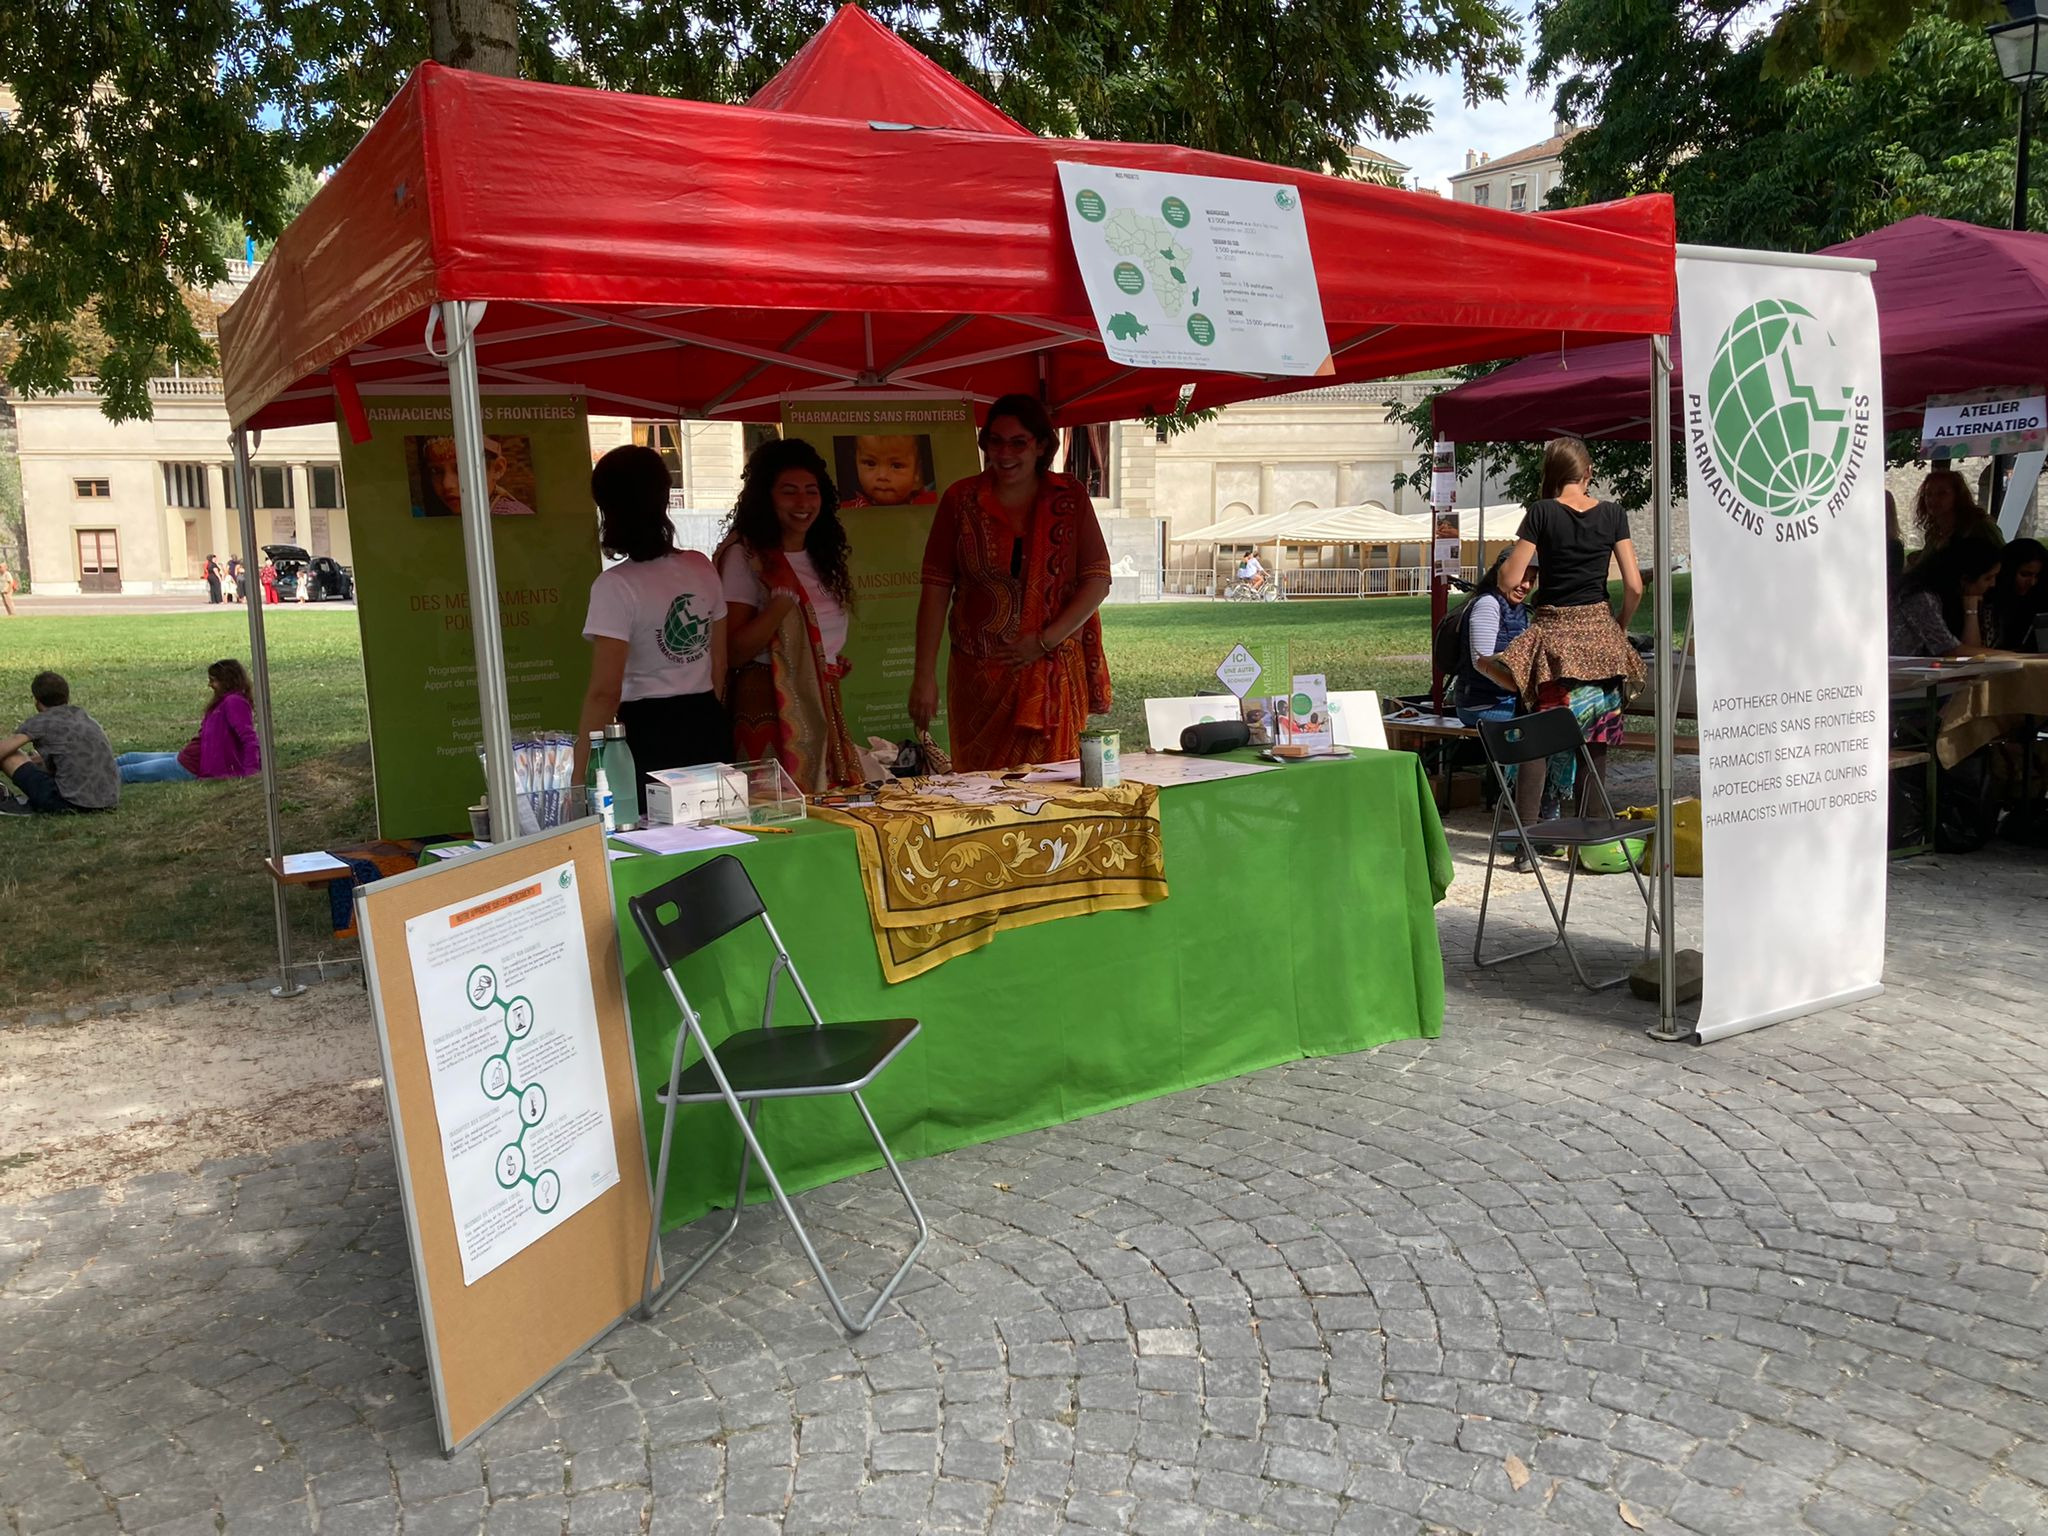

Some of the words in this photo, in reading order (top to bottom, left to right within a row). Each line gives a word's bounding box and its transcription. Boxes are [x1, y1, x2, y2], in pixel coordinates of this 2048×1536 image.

[364, 408, 452, 422] ARMACIENS
[791, 411, 871, 423] PHARMACIENS
[873, 410, 902, 422] SANS
[1959, 401, 2020, 418] ATELIER
[1935, 416, 2039, 437] ALTERNATIBO
[1688, 394, 1765, 537] PHARMACIENS
[1775, 514, 1819, 543] SANS
[858, 571, 919, 589] MISSIONS
[410, 594, 441, 611] DES
[1232, 653, 1247, 663] ICI
[1262, 644, 1272, 694] MEMBRE
[1712, 693, 1778, 712] APOTHEKER
[1780, 690, 1813, 705] OHNE
[1816, 685, 1863, 702] GRENZEN
[1703, 722, 1778, 742] PHARMACIENS
[1780, 718, 1811, 733] SANS
[1814, 710, 1876, 729] FRONTIÈRES
[1709, 751, 1772, 770] FARMACISTI
[1775, 746, 1811, 762] SENZA
[1814, 737, 1869, 755] FRONTIERE
[1712, 776, 1782, 798] APOTECHERS
[1785, 771, 1822, 787] SENZA
[1824, 765, 1868, 781] CUNFINS
[1706, 805, 1777, 828] PHARMACISTS
[1779, 797, 1827, 815] WITHOUT
[1829, 790, 1877, 808] BORDERS
